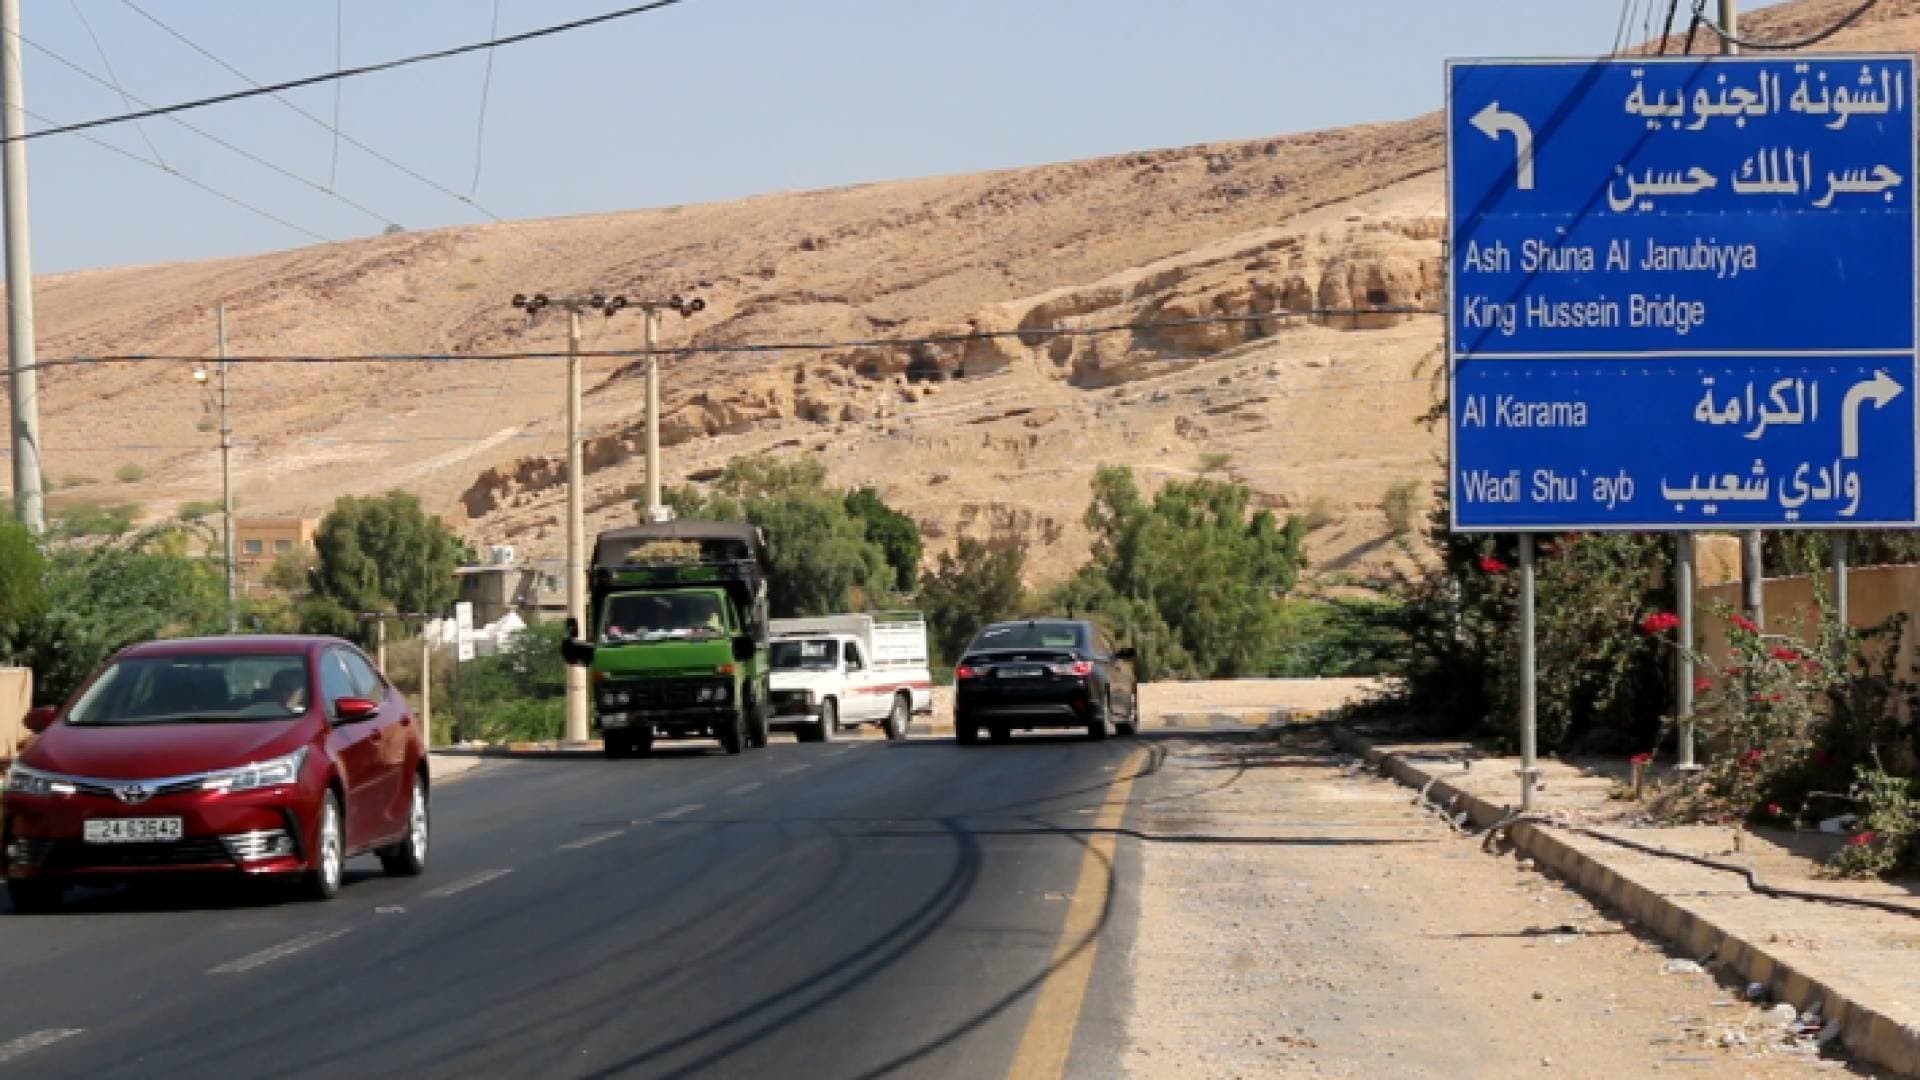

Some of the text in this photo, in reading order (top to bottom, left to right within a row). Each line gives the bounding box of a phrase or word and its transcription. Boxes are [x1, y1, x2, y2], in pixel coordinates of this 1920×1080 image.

[1625, 64, 1903, 130] الشونة الجنوبية
[1608, 147, 1903, 212] جسر الملك حسين
[1464, 239, 1510, 272] Ash
[1606, 239, 1630, 272] Al
[1641, 237, 1757, 279] Janubiyya
[1463, 294, 1705, 335] King Hussein Bridge
[1463, 396, 1588, 427] Al Karama
[1695, 377, 1819, 439] الكرامة
[1461, 469, 1520, 502] Wadi
[1660, 458, 1861, 520] وادي شعيب
